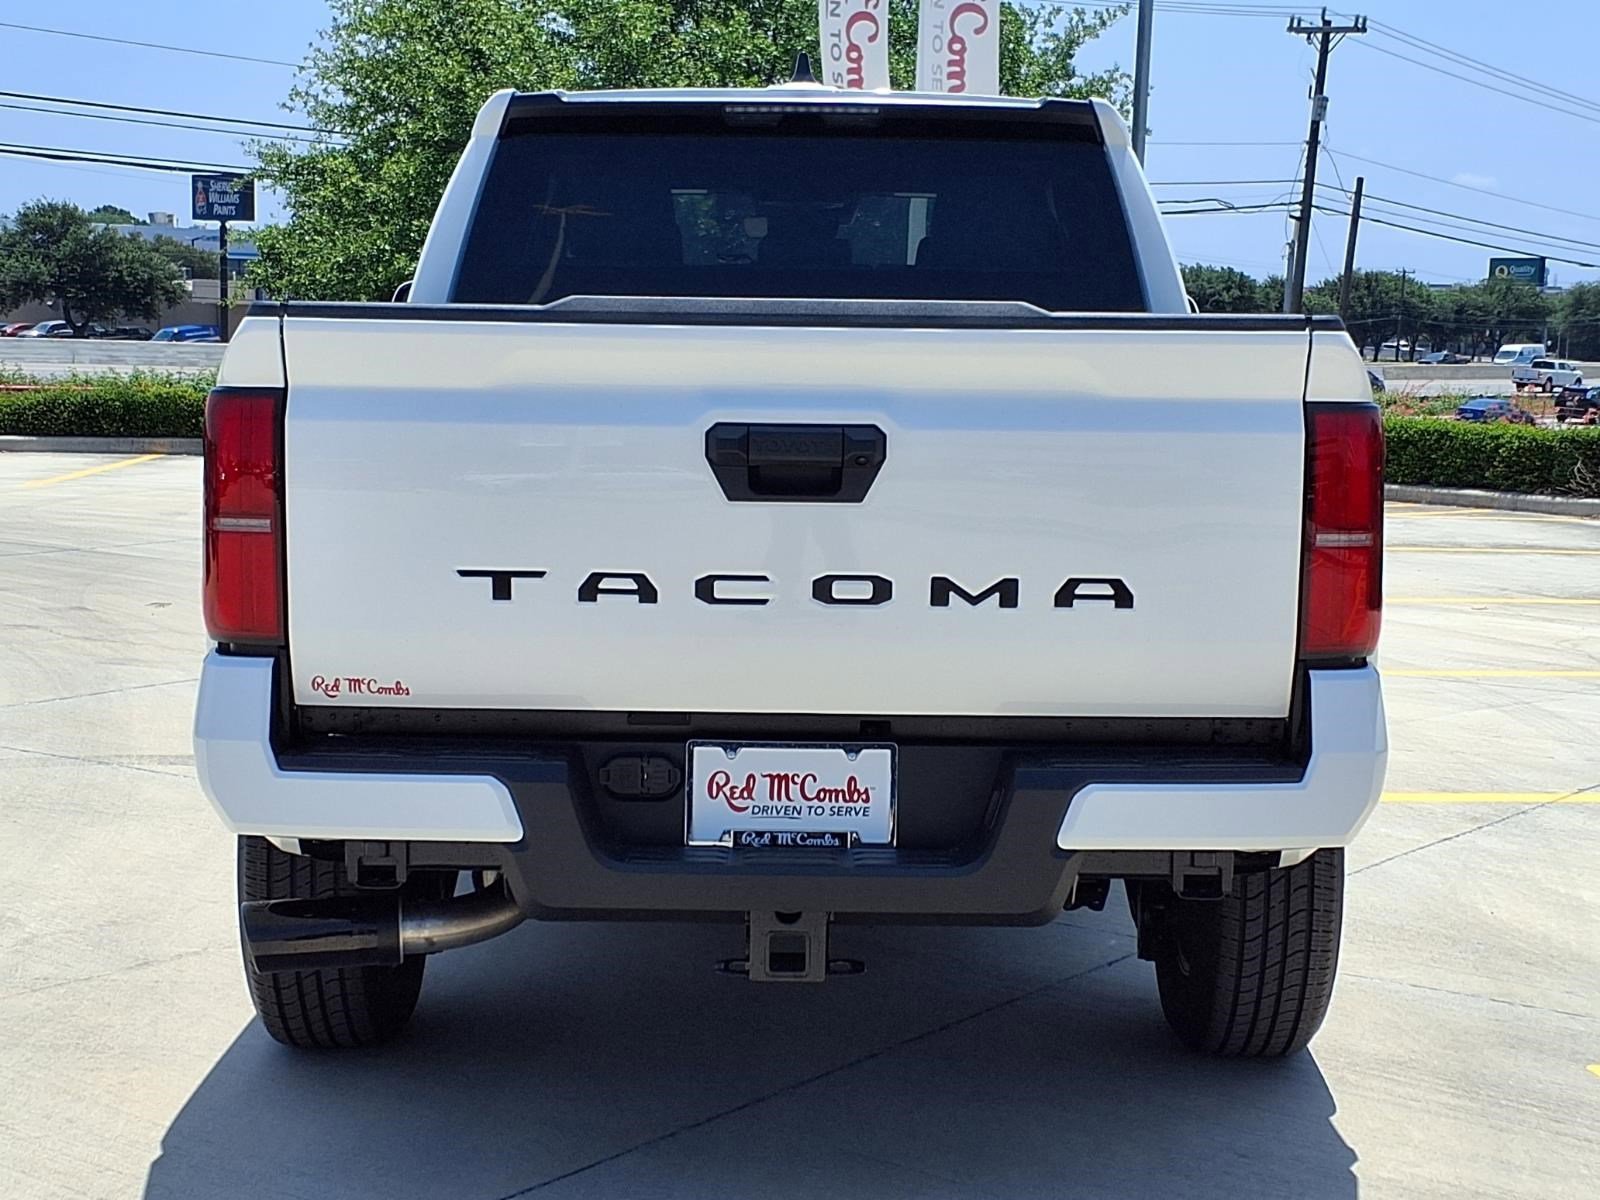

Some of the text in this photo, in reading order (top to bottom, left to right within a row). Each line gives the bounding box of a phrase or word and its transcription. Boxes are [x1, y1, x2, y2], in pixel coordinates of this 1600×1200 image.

[830, 28, 842, 62] TO
[932, 20, 944, 54] TO
[946, 0, 989, 93] Com
[209, 191, 240, 204] WILLIAMS
[213, 203, 236, 216] PAINTS
[456, 569, 1134, 609] TACOMA
[311, 675, 411, 698] Red McCombs
[707, 770, 871, 813] Red McCombs
[751, 804, 871, 818] DRIVEN TO SERVE
[741, 831, 840, 848] Red McCombs
